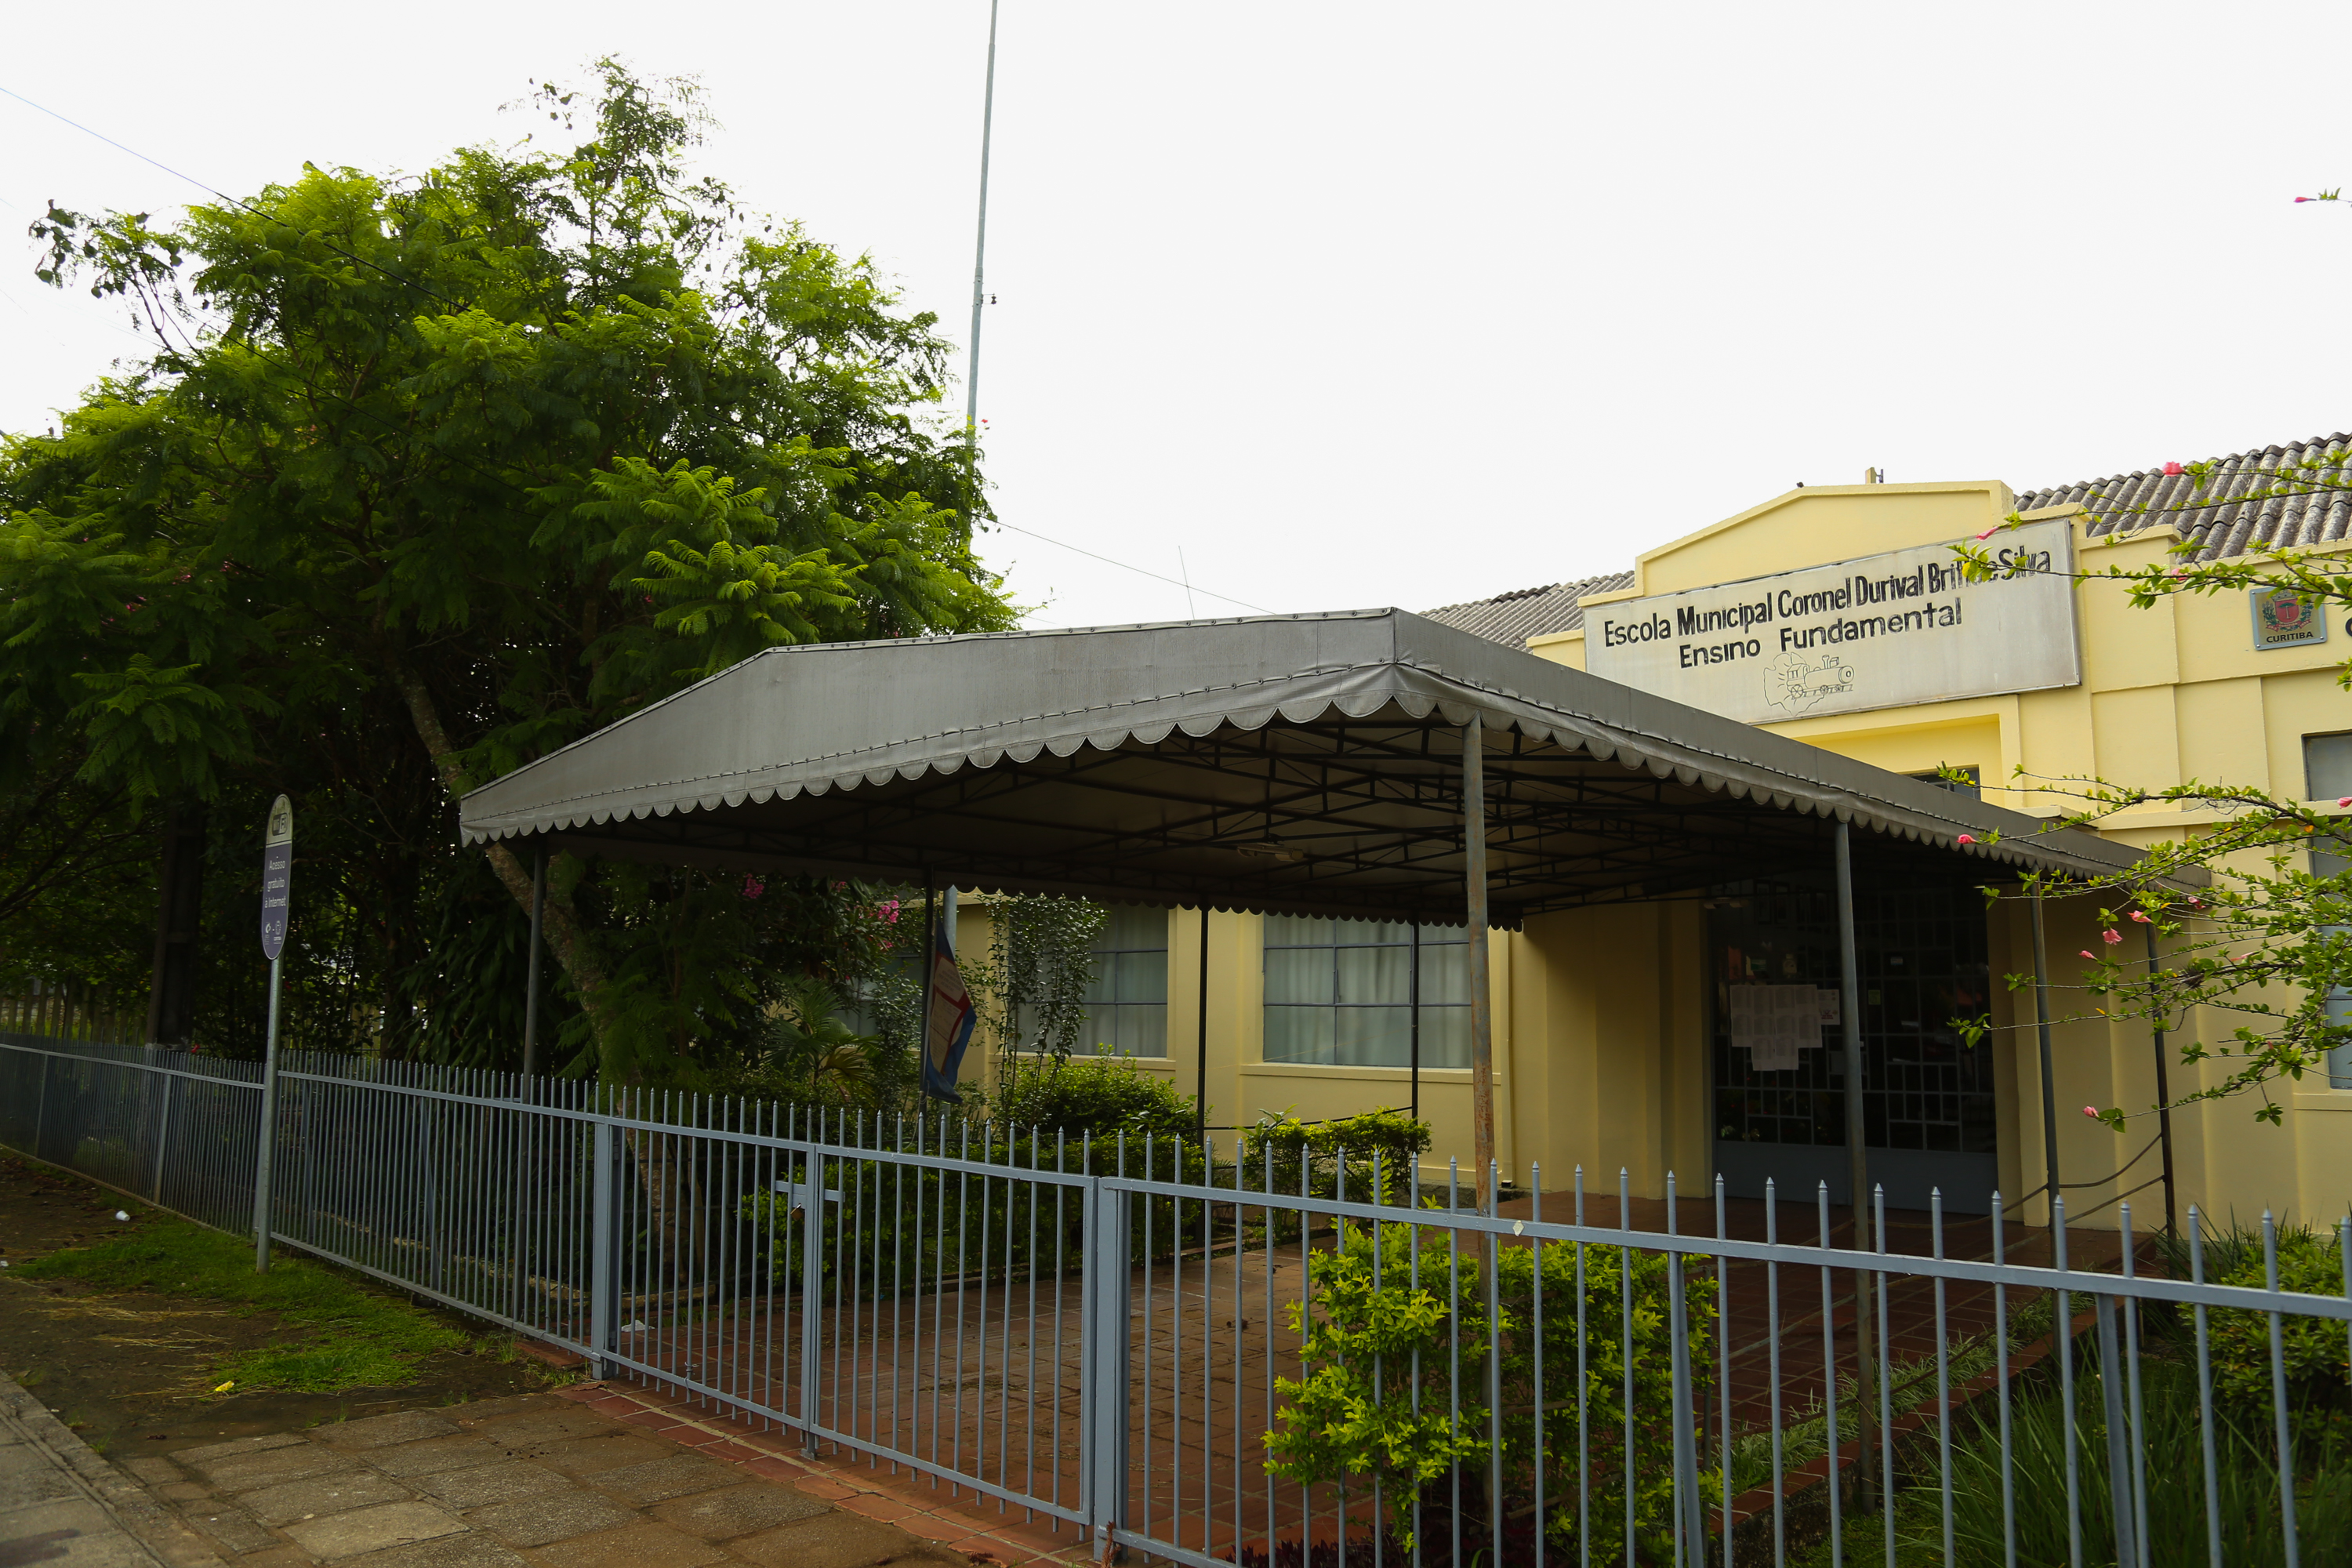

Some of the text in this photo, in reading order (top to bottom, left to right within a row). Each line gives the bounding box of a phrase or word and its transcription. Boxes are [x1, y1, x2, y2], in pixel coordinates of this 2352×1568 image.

[1604, 612, 1671, 648] Escola
[1676, 592, 1773, 634] Municipal
[1777, 577, 1852, 619] Coronel
[1855, 564, 1924, 607] Durival
[1998, 545, 2051, 581] Silva
[1679, 597, 1962, 669] Ensino Fundamental
[2266, 631, 2314, 643] CURITIBA
[268, 860, 286, 871] Acesso
[267, 877, 285, 892] gratuito
[268, 895, 286, 908] Internet
